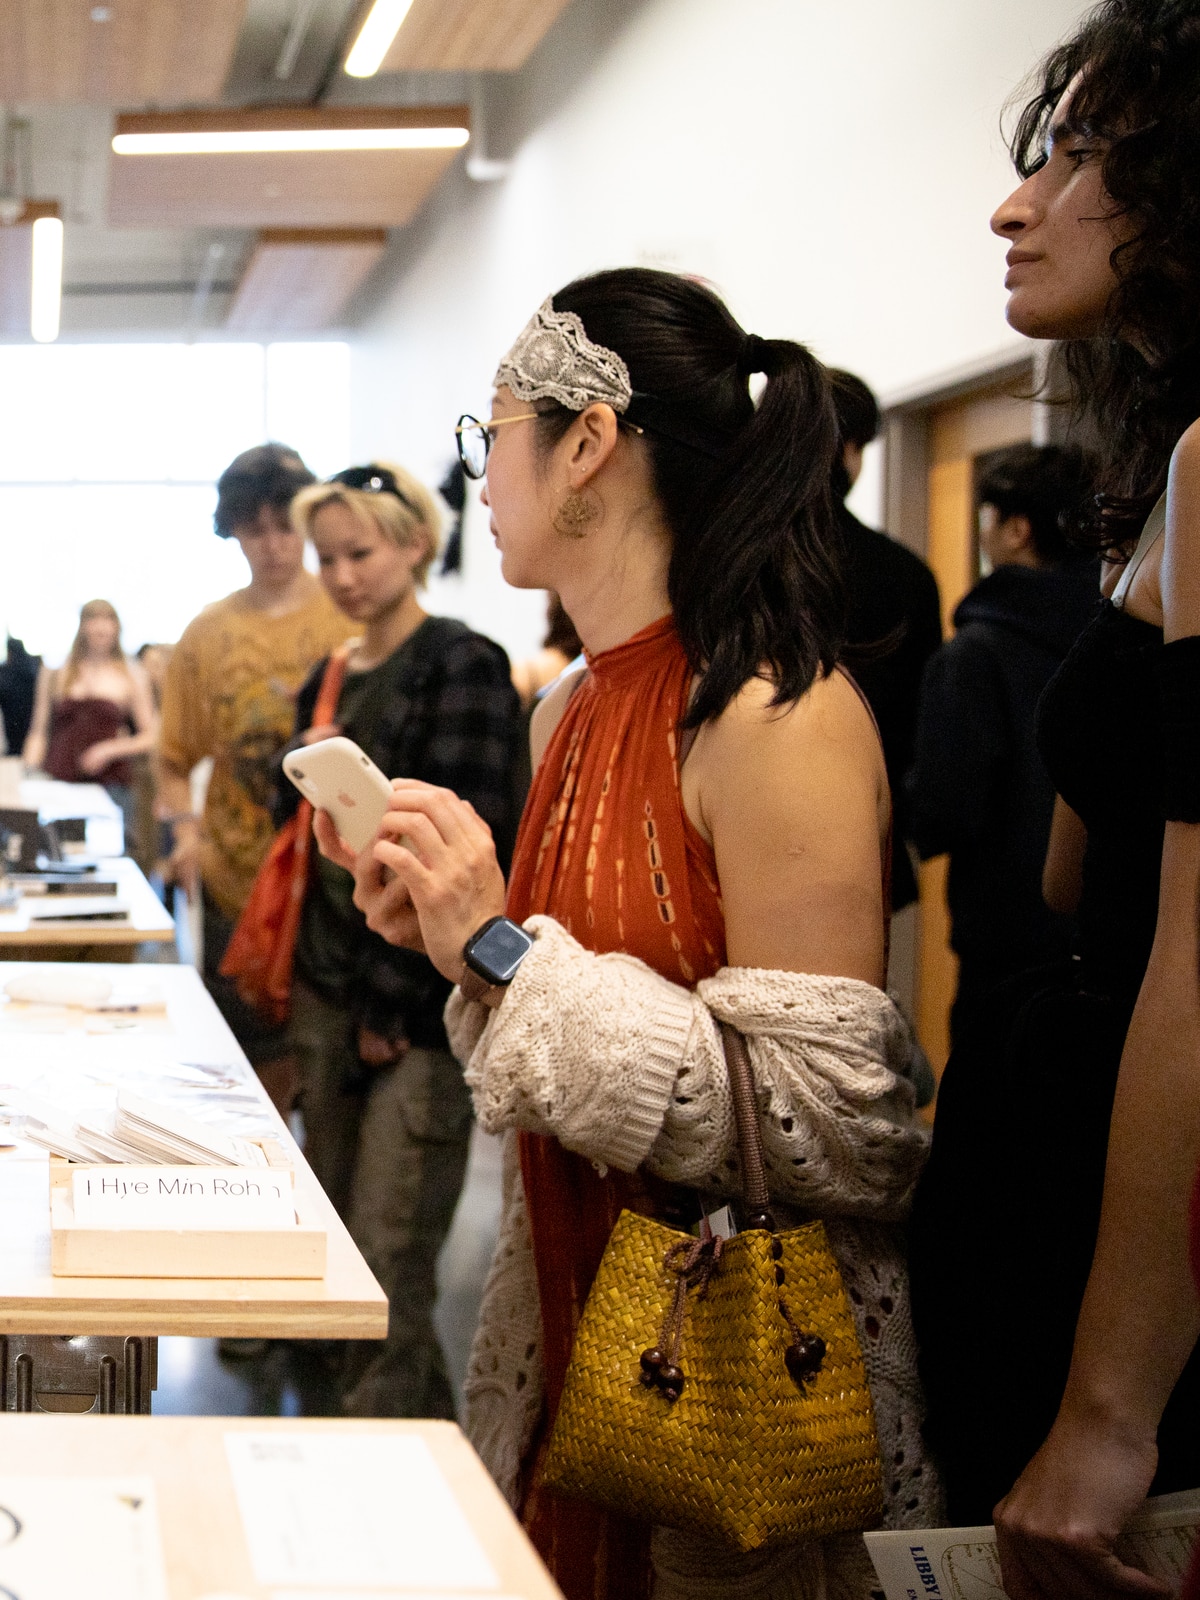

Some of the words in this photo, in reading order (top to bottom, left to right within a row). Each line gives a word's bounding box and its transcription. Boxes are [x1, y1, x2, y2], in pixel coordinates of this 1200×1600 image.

[102, 1178, 148, 1199] Hye
[158, 1178, 204, 1195] Min
[213, 1179, 261, 1196] Roh
[909, 1546, 940, 1595] LIBBY
